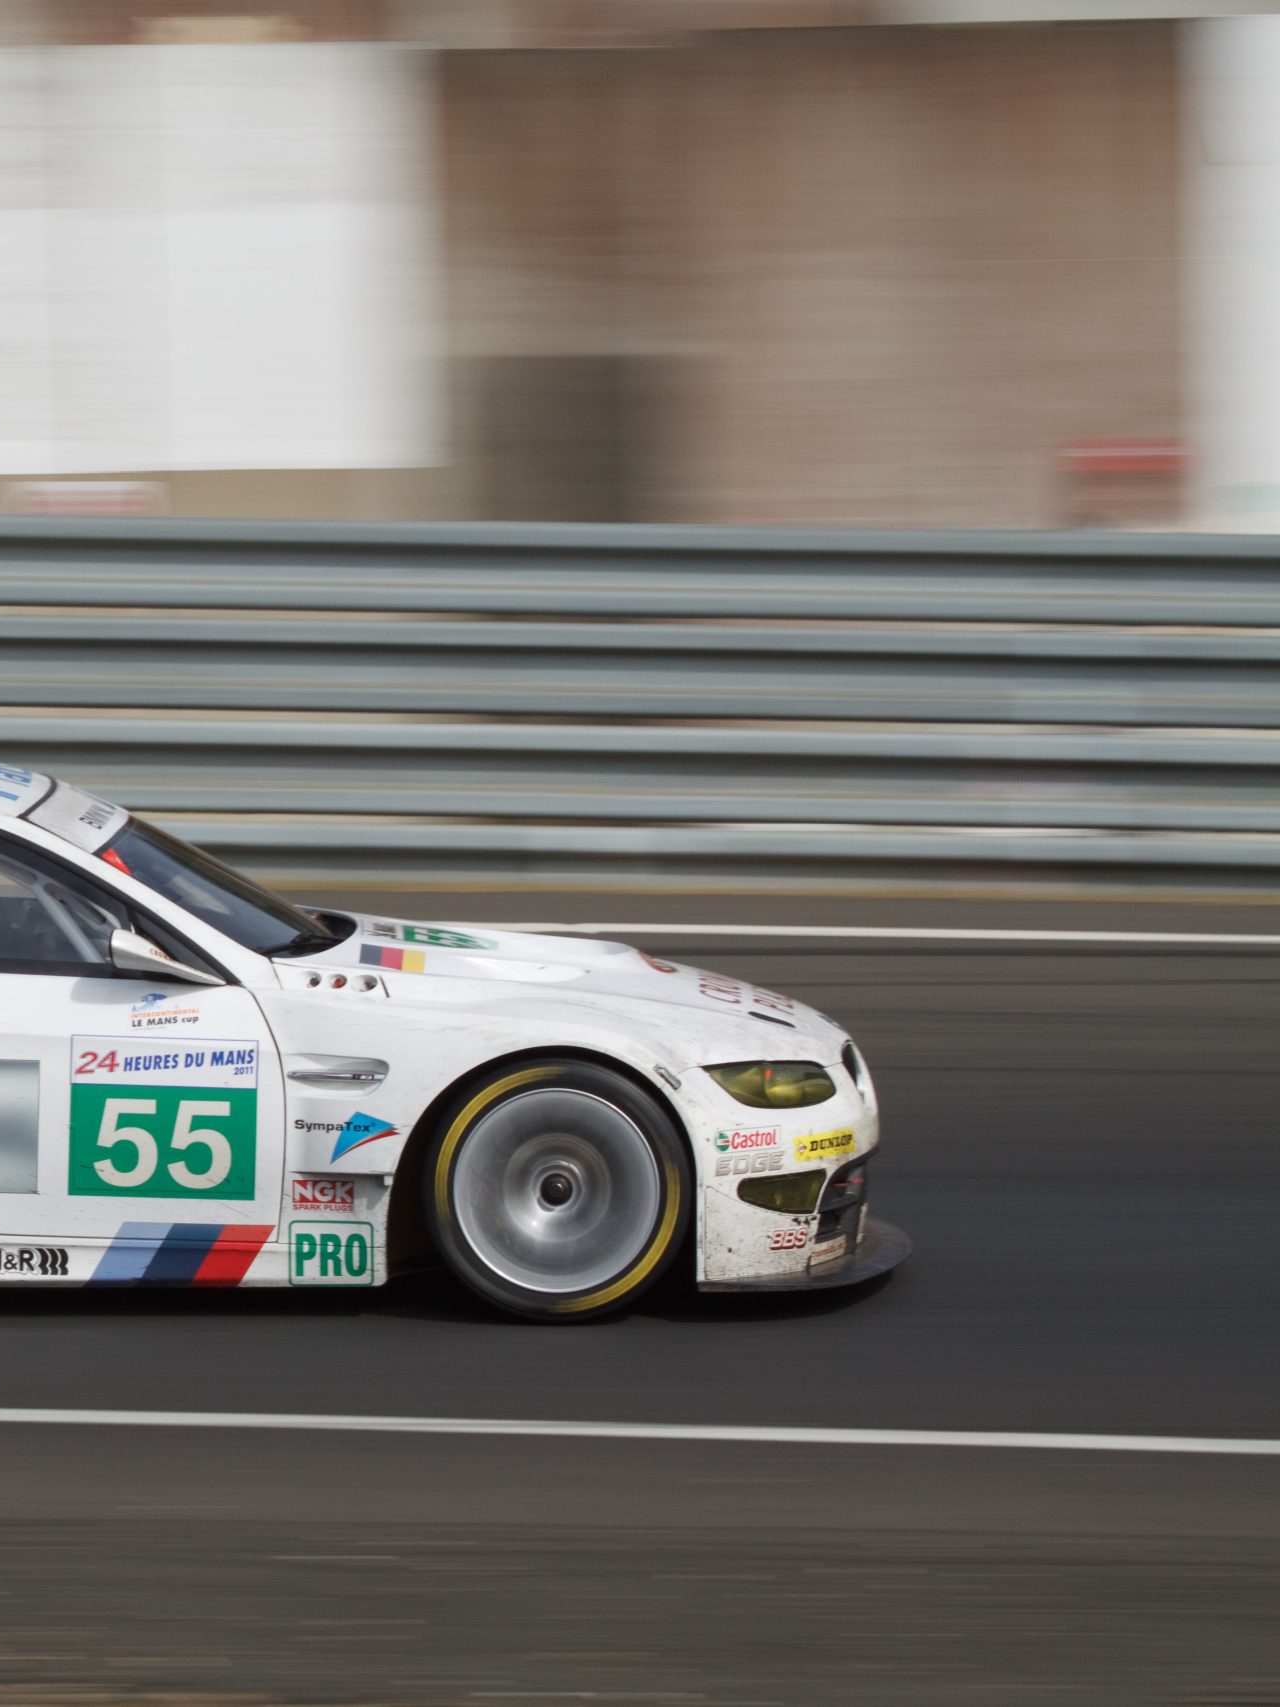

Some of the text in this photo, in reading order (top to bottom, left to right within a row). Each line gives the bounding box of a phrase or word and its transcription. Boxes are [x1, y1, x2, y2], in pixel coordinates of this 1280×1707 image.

[131, 1016, 200, 1028] LE MANS cup
[73, 1048, 255, 1075] 24 HEURES DU MANS
[233, 1066, 254, 1076] 2011
[92, 1097, 233, 1190] 55
[730, 1128, 778, 1150] Castrol
[808, 1133, 853, 1153] DUNLOP
[714, 1151, 786, 1177] EDGE
[293, 1180, 354, 1204] NGK
[292, 1204, 354, 1212] SPARK PLUGS
[768, 1228, 808, 1251] BBS
[295, 1232, 368, 1277] PRO
